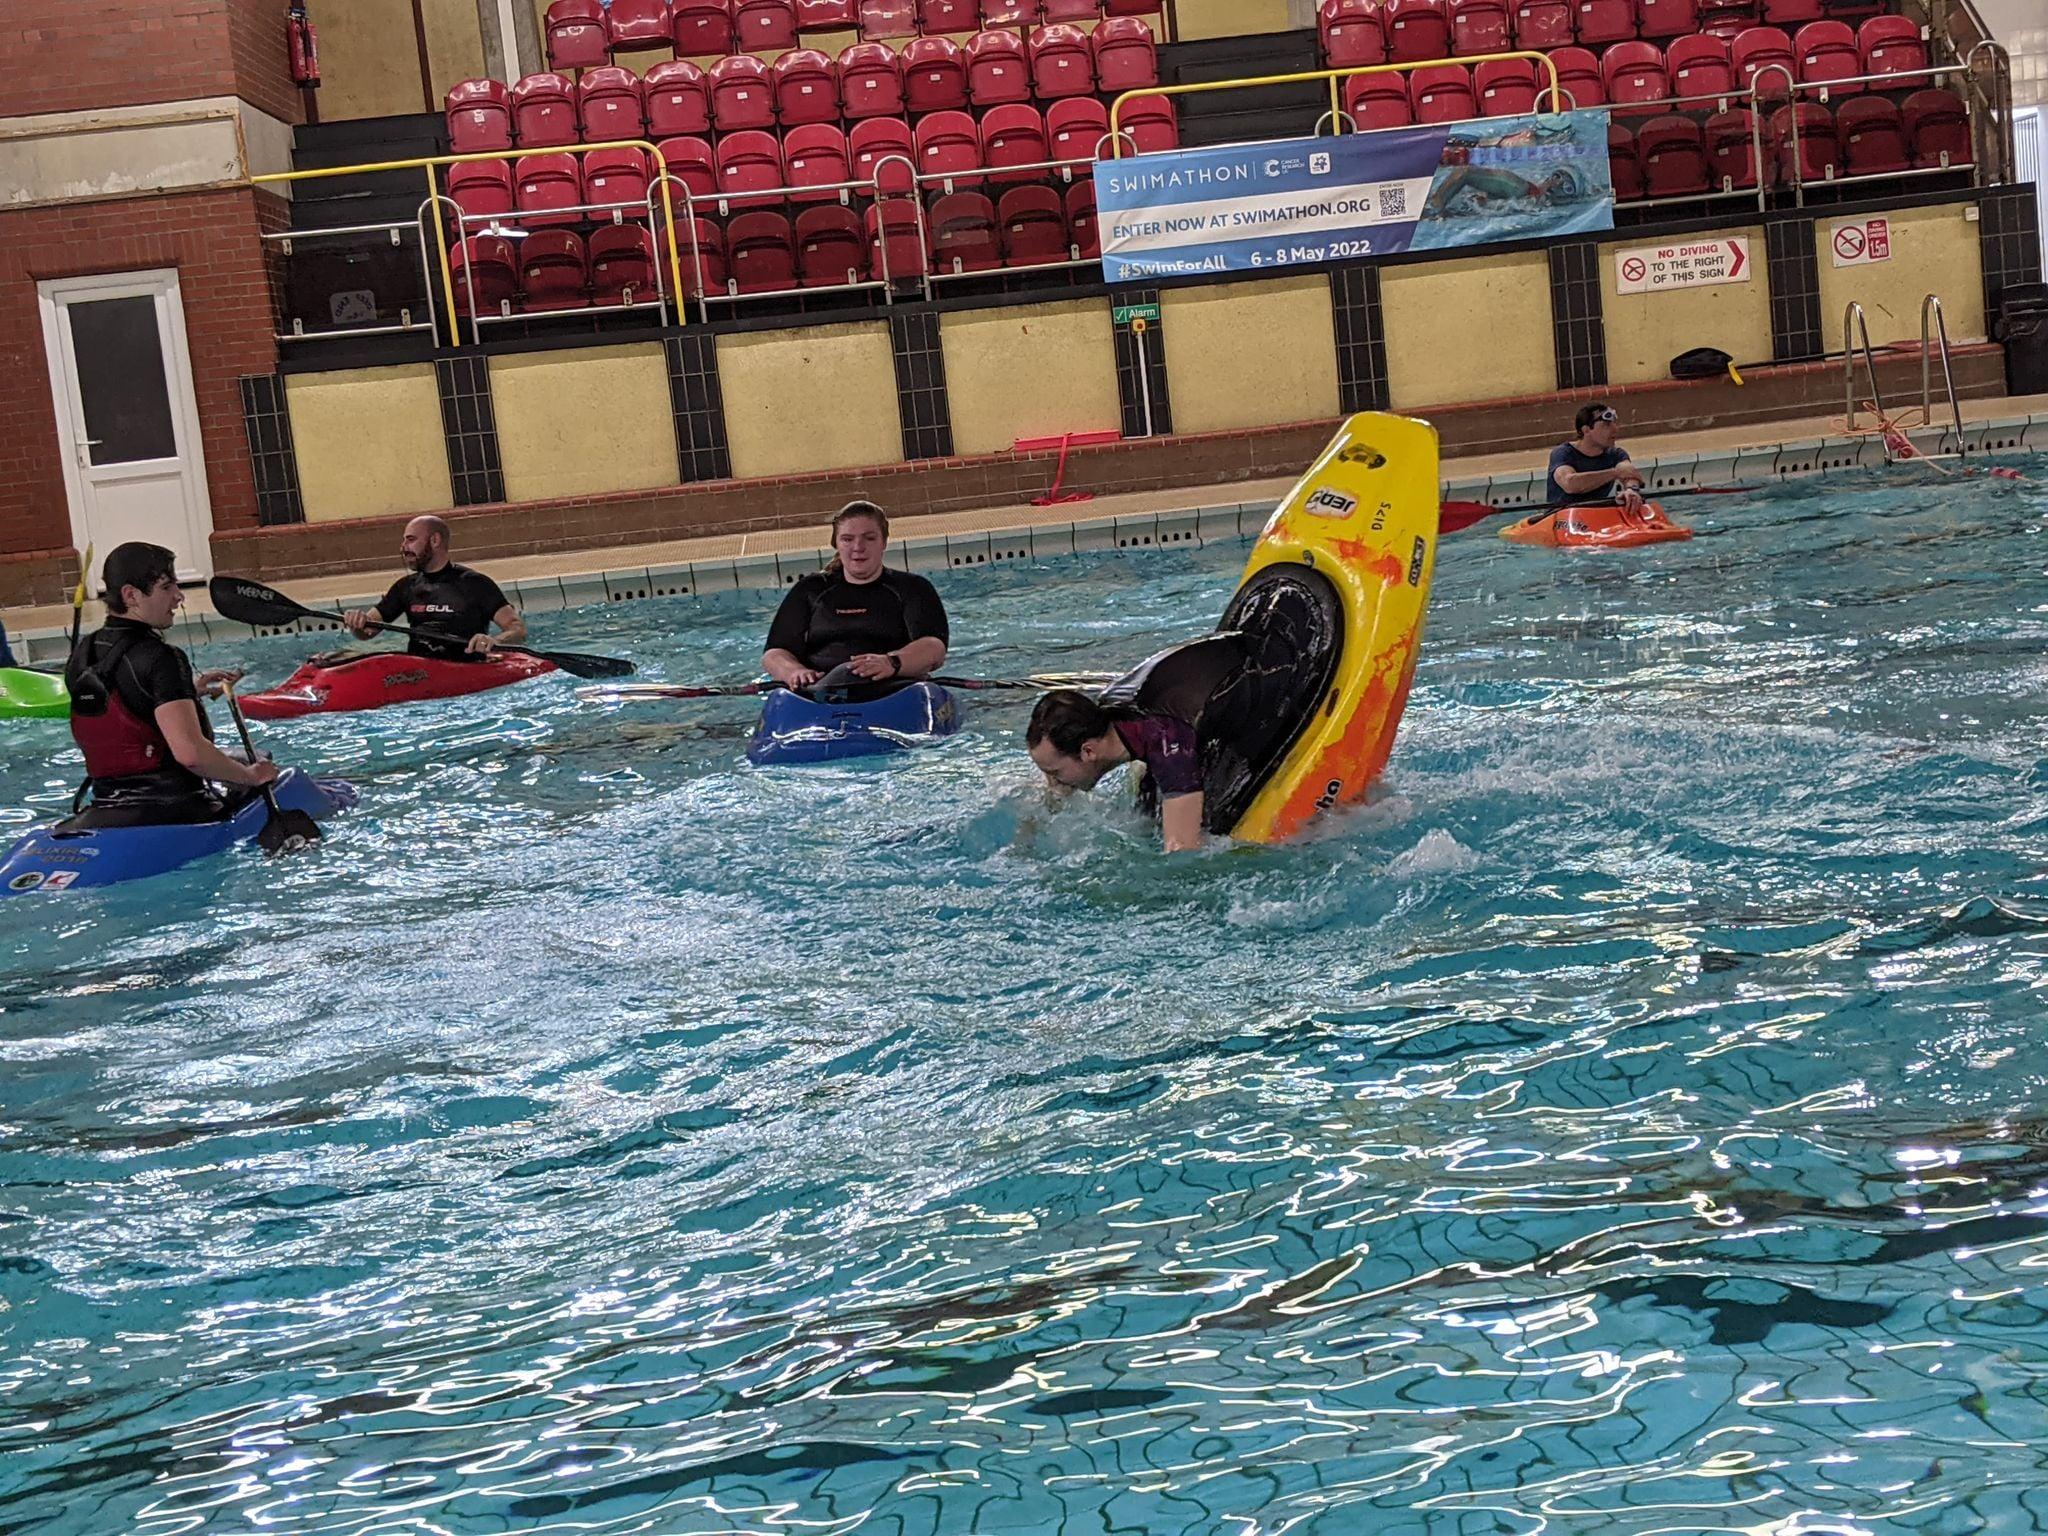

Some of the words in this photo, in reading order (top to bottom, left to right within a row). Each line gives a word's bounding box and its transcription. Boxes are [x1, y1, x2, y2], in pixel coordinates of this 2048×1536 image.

[1110, 164, 1248, 193] SWIMATHON
[1113, 222, 1161, 239] ENTER
[1166, 216, 1206, 233] NOW
[1210, 214, 1228, 228] AT
[1233, 198, 1371, 226] SWIMATHON.ORG
[1251, 251, 1261, 265] 6
[1276, 249, 1288, 263] 8
[1291, 246, 1325, 261] May
[1329, 240, 1371, 257] 2022
[1658, 249, 1675, 259] NO
[1680, 244, 1719, 257] DIVING
[1118, 254, 1227, 279] #SwimForAll
[1650, 262, 1665, 272] TO
[1670, 259, 1689, 270] THE
[1694, 255, 1725, 267] RIGHT
[1653, 274, 1667, 284] OF
[1671, 271, 1695, 282] THIS
[1700, 268, 1724, 279] SIGN
[1129, 308, 1156, 319] Alarm
[426, 604, 454, 613] GUL
